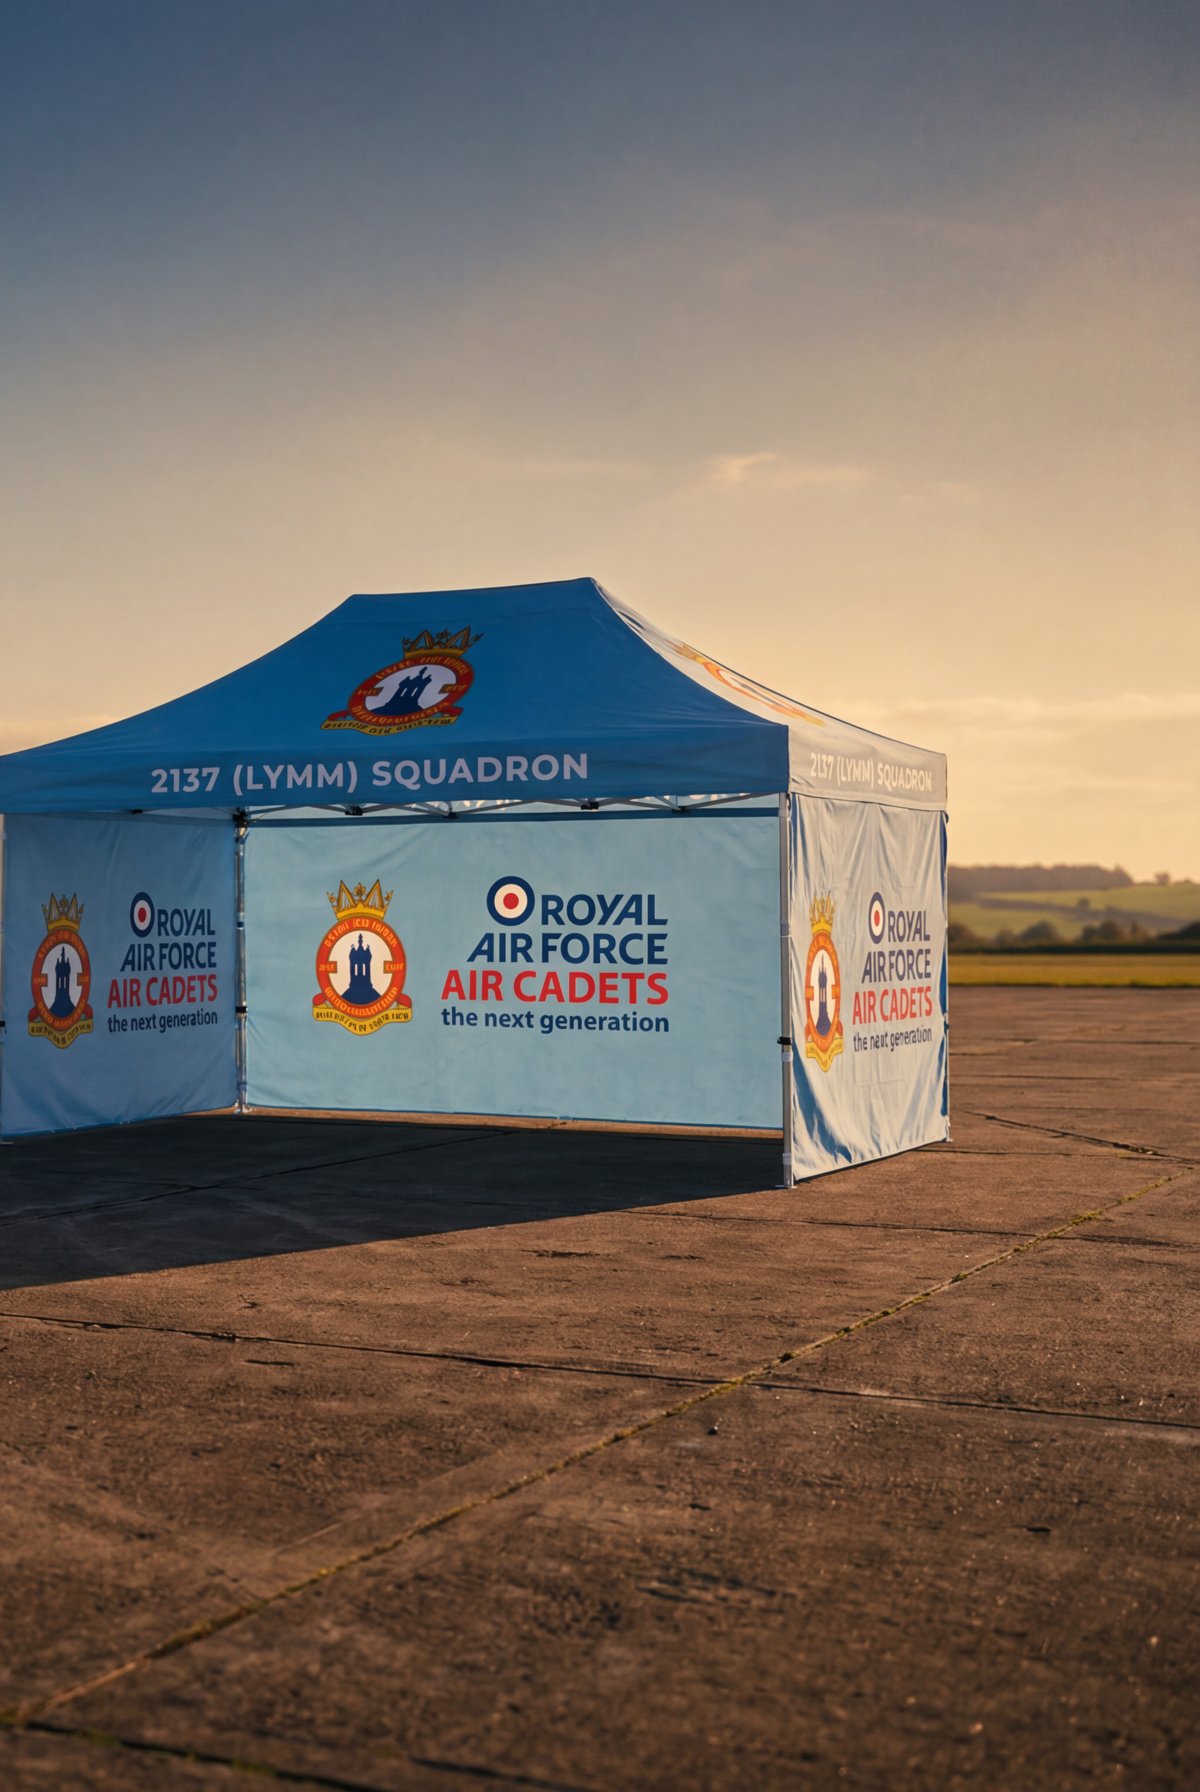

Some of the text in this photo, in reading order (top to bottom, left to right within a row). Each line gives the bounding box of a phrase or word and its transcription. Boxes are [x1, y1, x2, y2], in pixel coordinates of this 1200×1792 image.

[151, 753, 587, 796] 2137 (LYMM) SQUADRON
[877, 762, 932, 792] SQUADRON
[157, 909, 215, 936] ROYAL
[541, 894, 668, 926] ROYAL
[888, 910, 930, 943] ROYAL
[120, 942, 217, 972] AIR FORCE
[467, 933, 668, 965] AIR FORCE
[861, 948, 931, 984] AIR FORCE
[107, 974, 217, 1008] AIR CADETS
[441, 969, 669, 1005] AIR CADETS
[108, 1009, 217, 1033] the next generation
[441, 1007, 669, 1034] the next generation
[852, 985, 932, 1025] AIR CADETS
[853, 1032, 867, 1052] the
